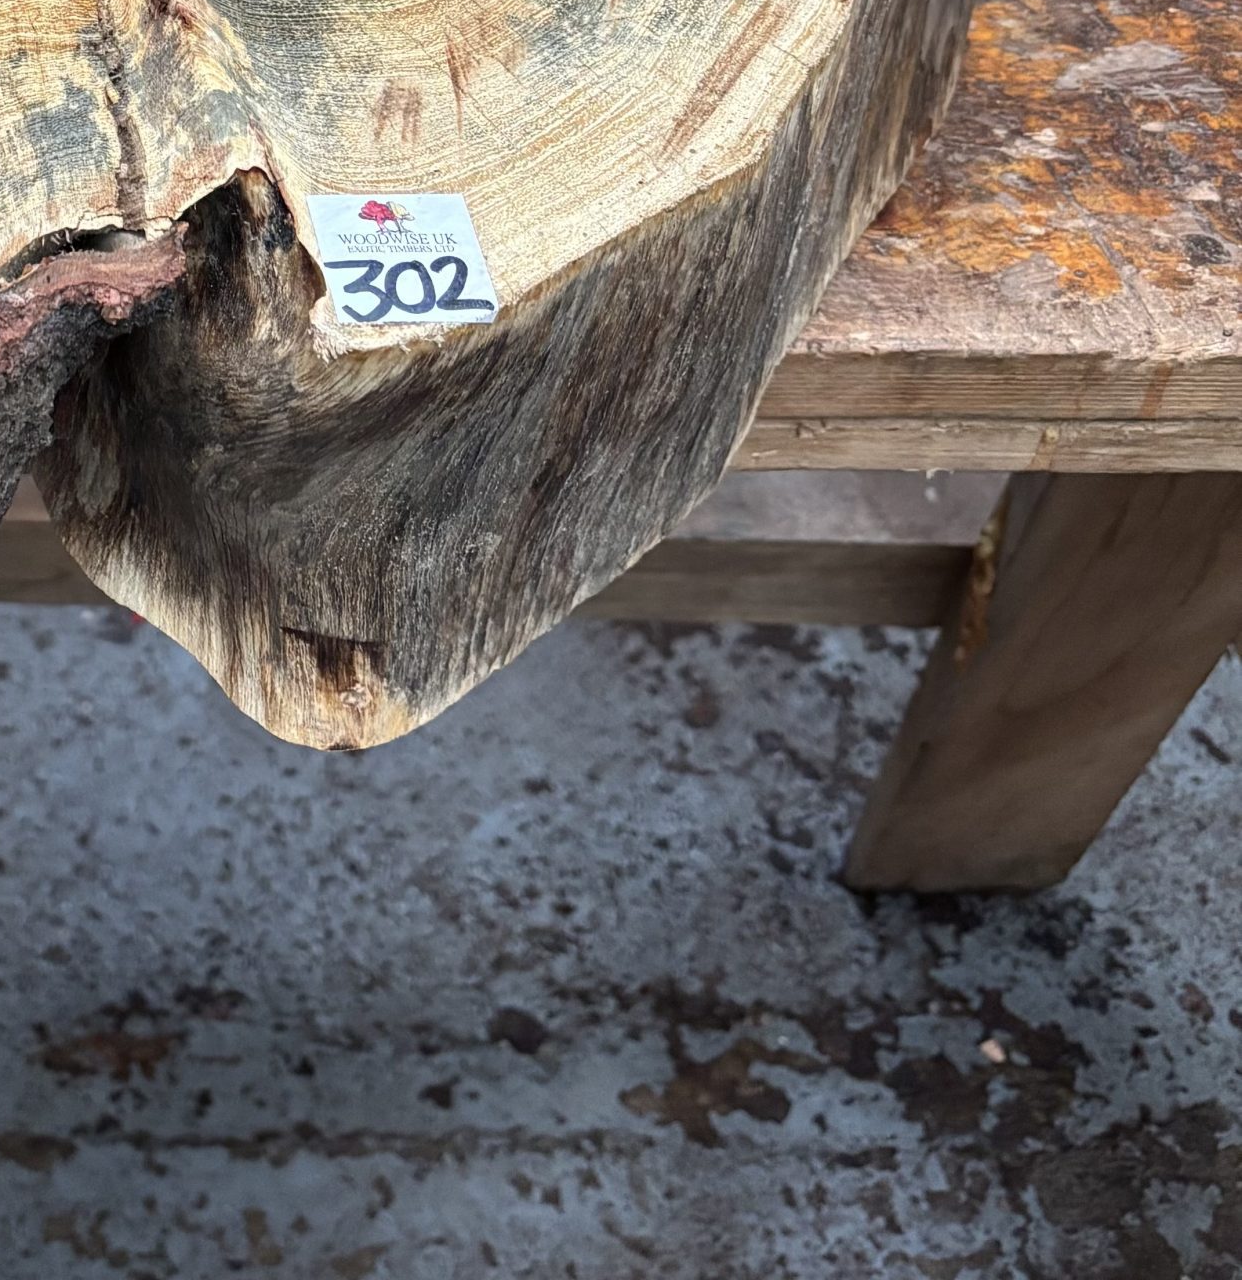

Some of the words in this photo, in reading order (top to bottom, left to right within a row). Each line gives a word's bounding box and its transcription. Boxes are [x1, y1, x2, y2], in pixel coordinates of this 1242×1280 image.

[338, 233, 430, 245] WOODWISE
[432, 233, 458, 245] UK
[347, 245, 386, 253] EXOTIC
[387, 245, 433, 253] TIMBERS
[434, 245, 455, 253] LTD
[323, 255, 495, 322] 302
